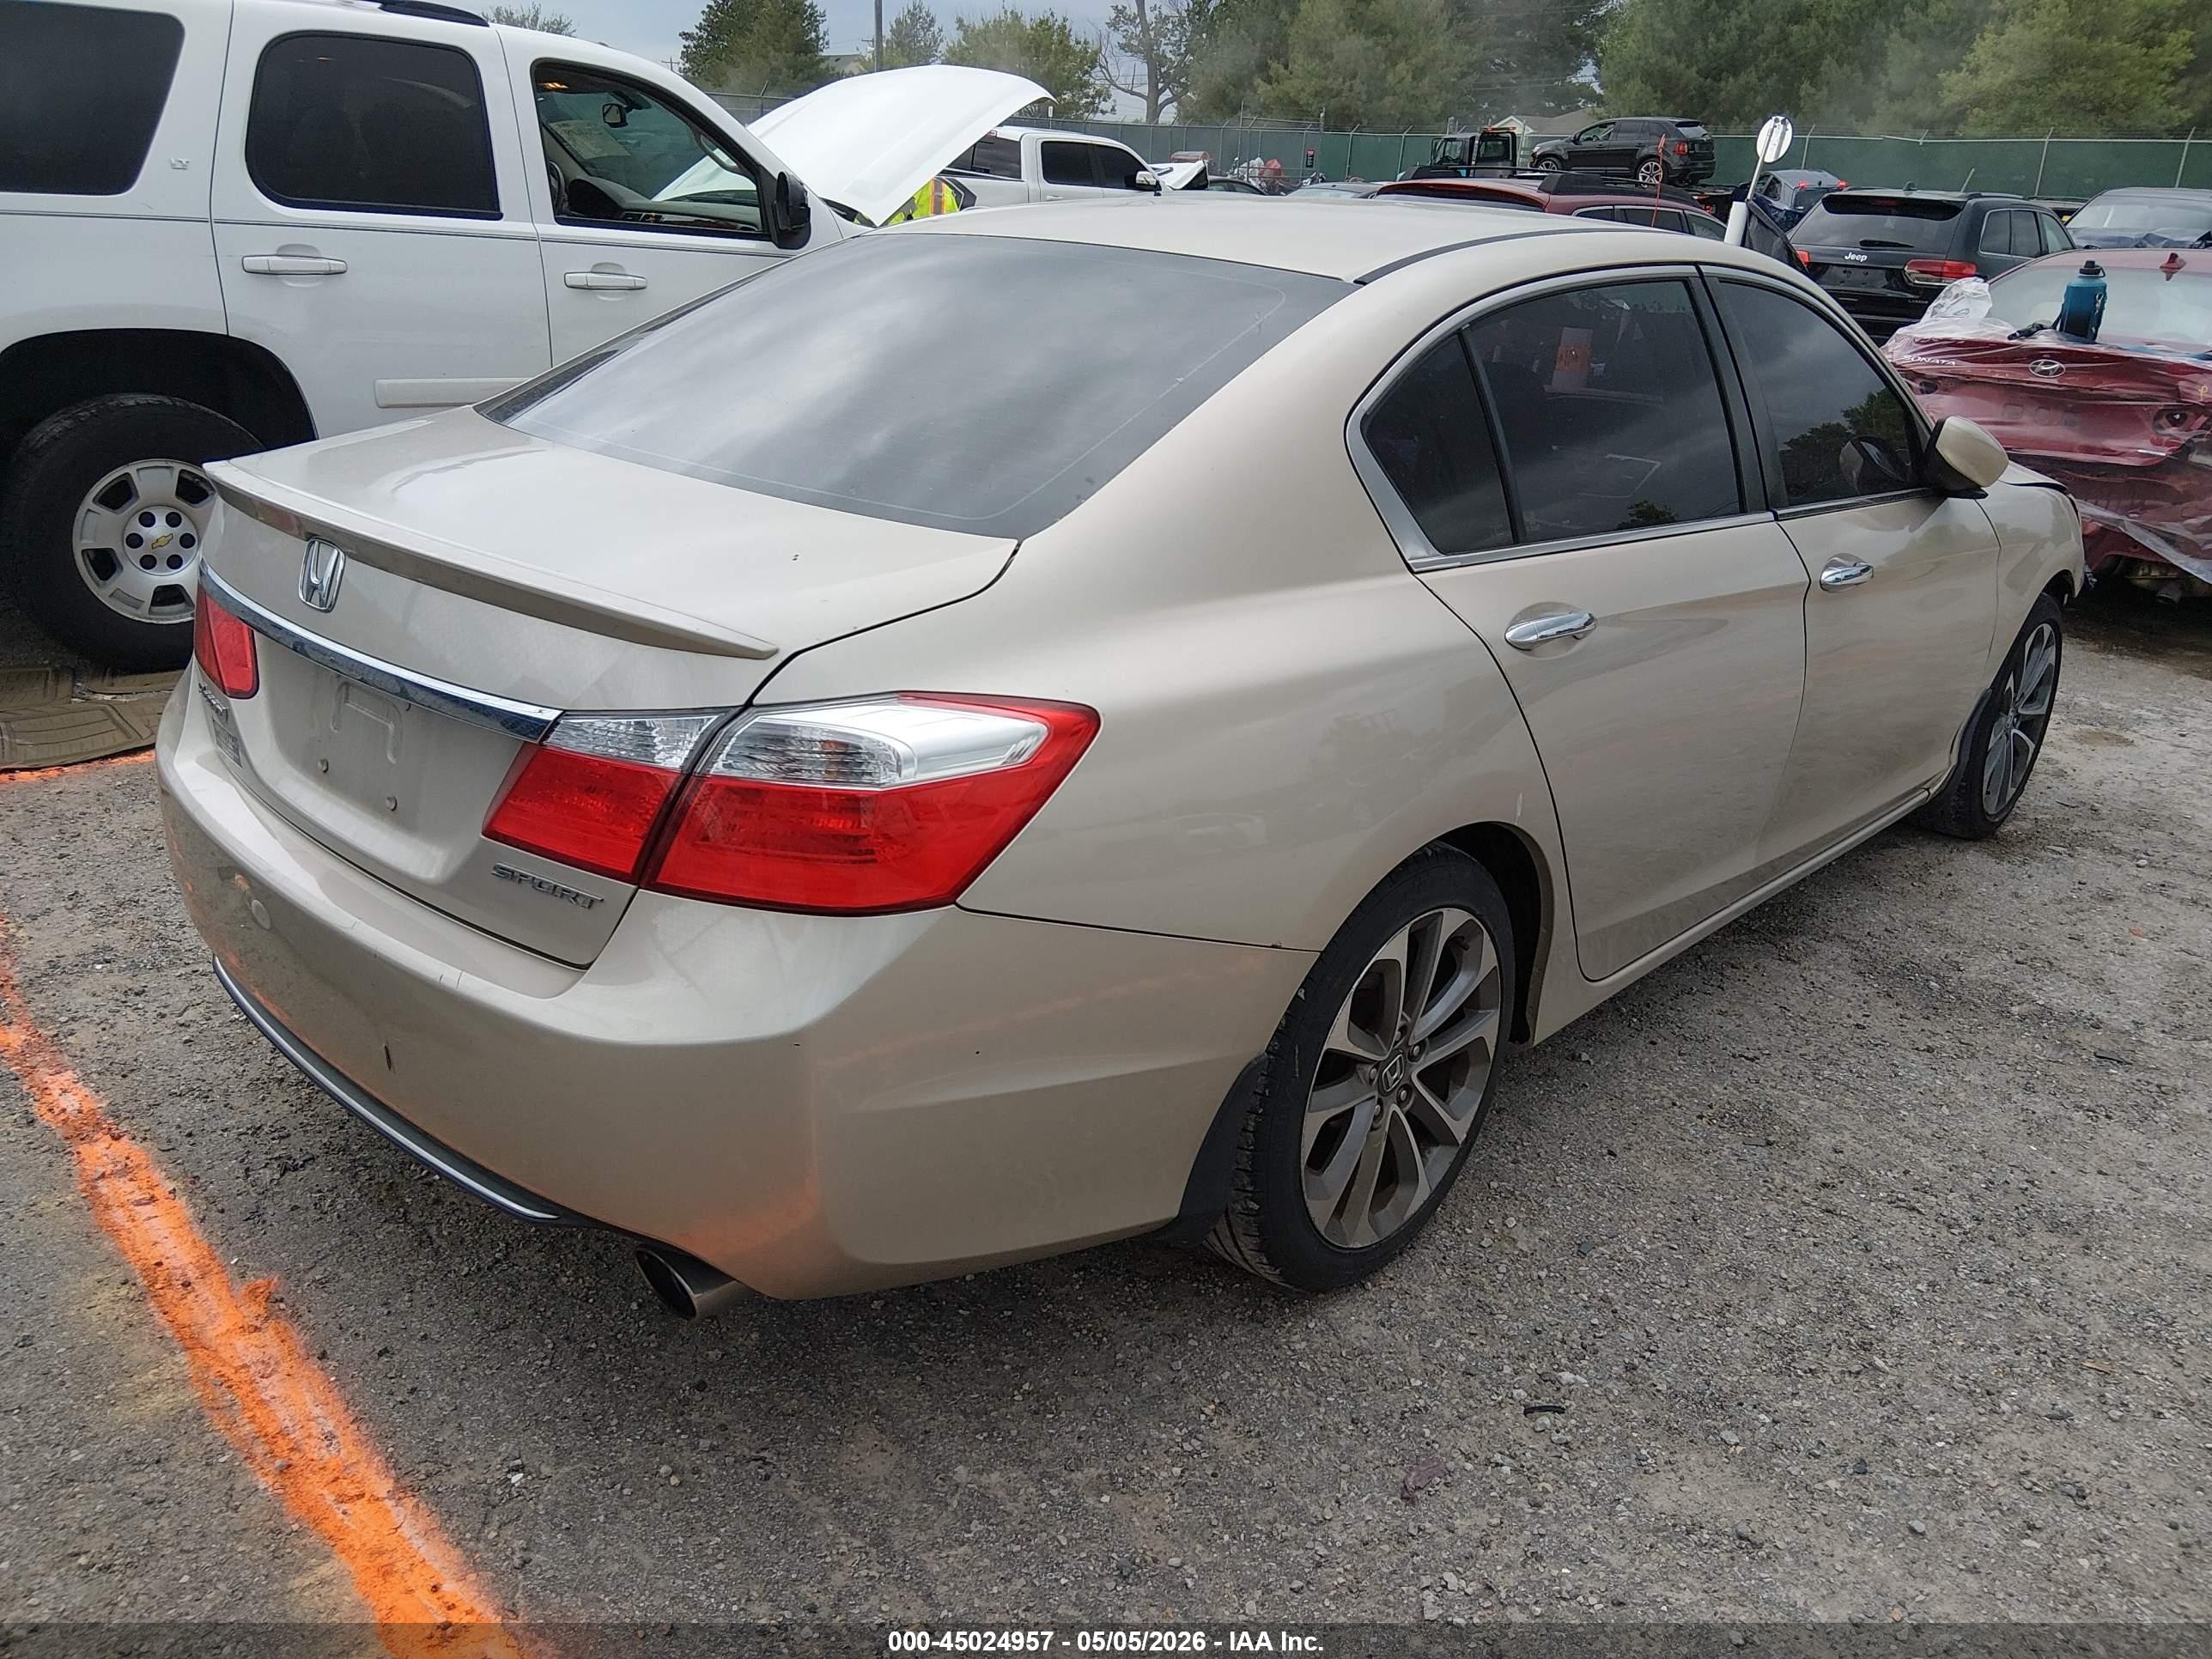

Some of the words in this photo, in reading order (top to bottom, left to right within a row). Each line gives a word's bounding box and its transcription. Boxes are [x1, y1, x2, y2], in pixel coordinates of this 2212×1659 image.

[1844, 252, 1868, 263] Jeep
[1902, 355, 1956, 366] SONATA
[491, 861, 605, 909] SPORT
